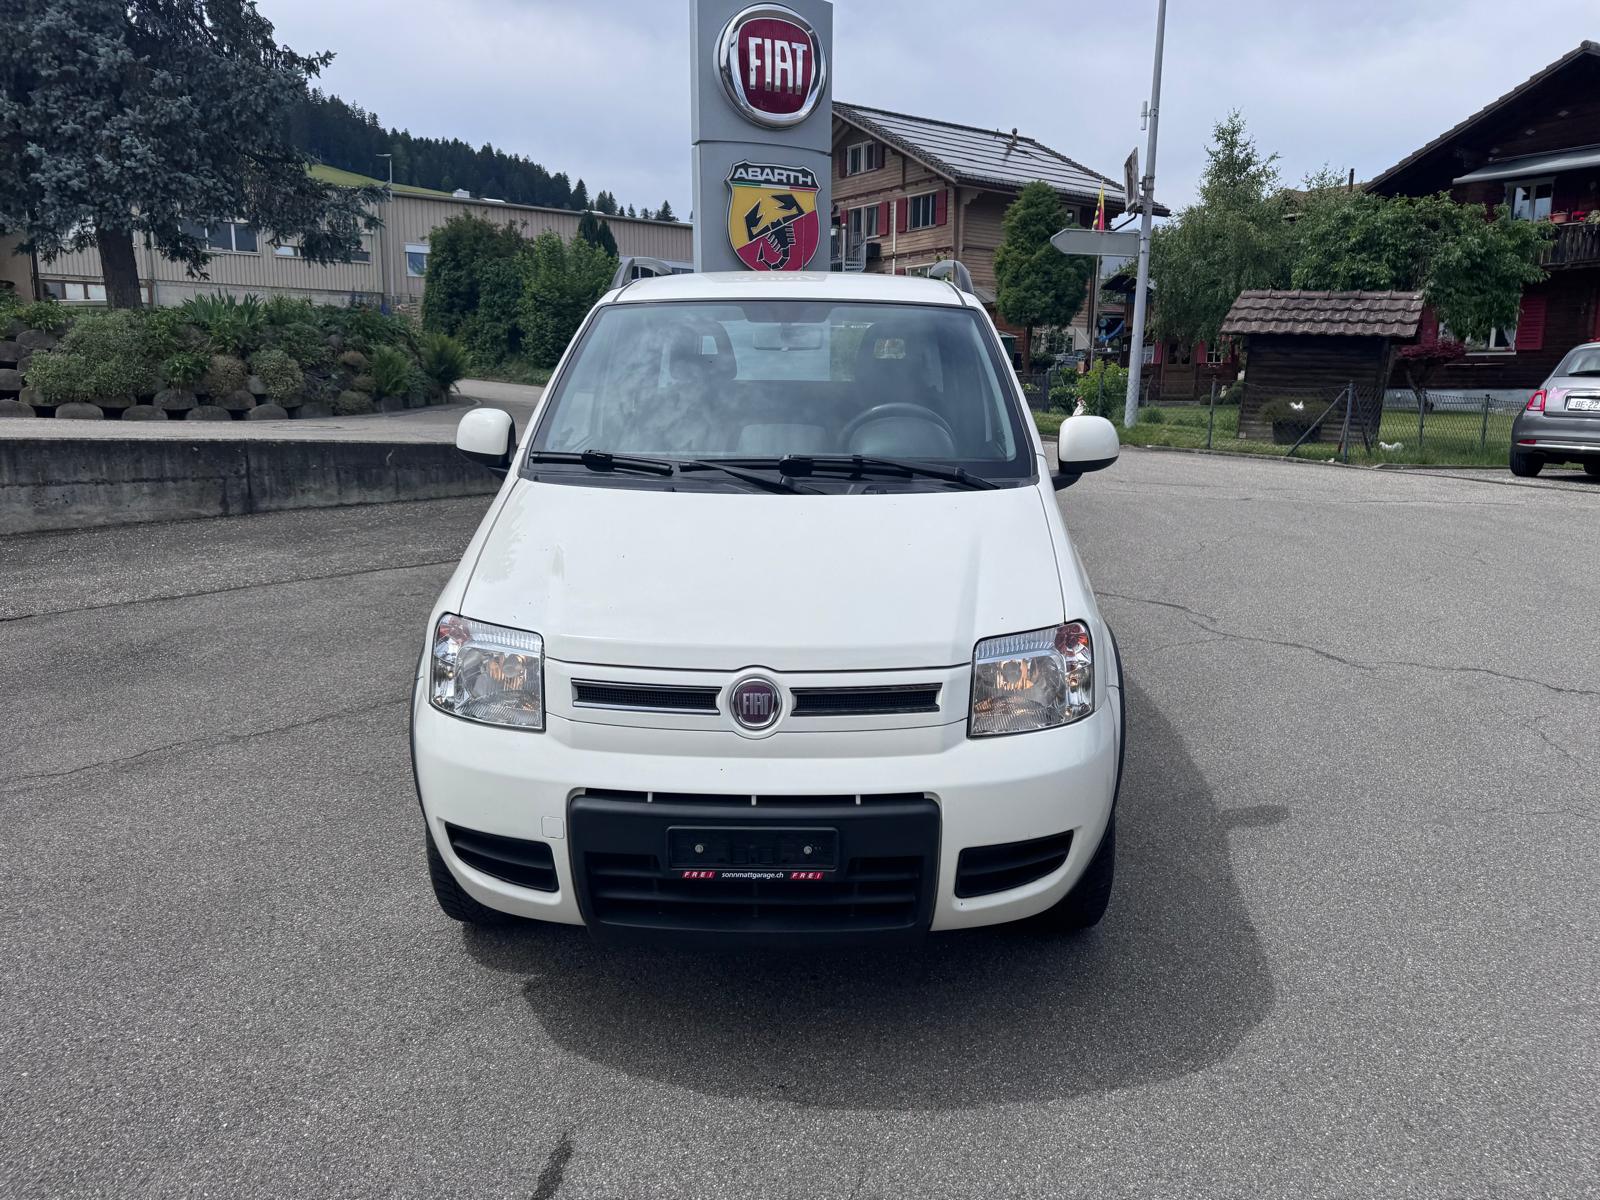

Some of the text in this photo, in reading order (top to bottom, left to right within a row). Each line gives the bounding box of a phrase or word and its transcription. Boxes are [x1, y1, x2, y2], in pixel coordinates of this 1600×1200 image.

[748, 36, 807, 95] FIAT
[733, 167, 812, 186] ABARTH
[743, 692, 771, 715] FIAT
[721, 871, 784, 880] sonnmattgarage.ch
